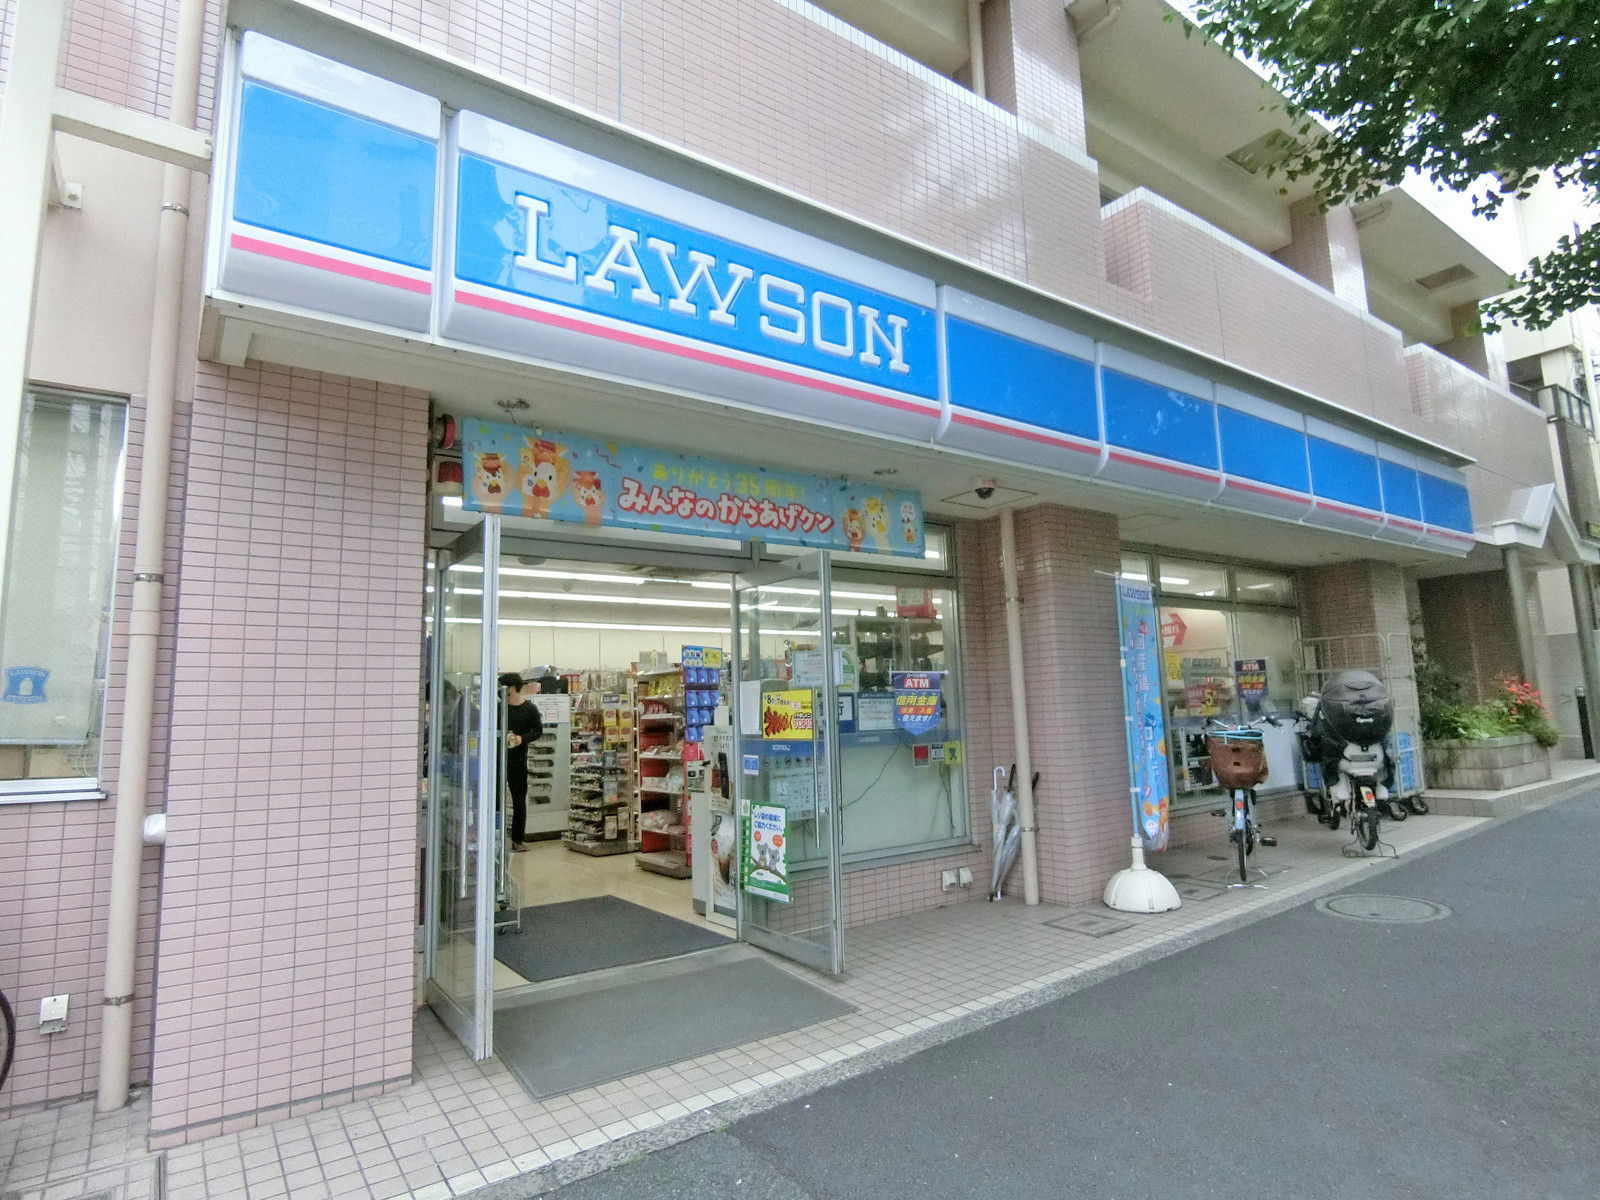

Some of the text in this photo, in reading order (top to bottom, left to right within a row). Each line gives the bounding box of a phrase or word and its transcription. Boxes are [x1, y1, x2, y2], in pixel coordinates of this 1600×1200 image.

[513, 192, 912, 375] LAWSON
[618, 477, 834, 533] みんなのからあげクン
[1121, 586, 1150, 600] LAWSON
[905, 678, 929, 688] ATM
